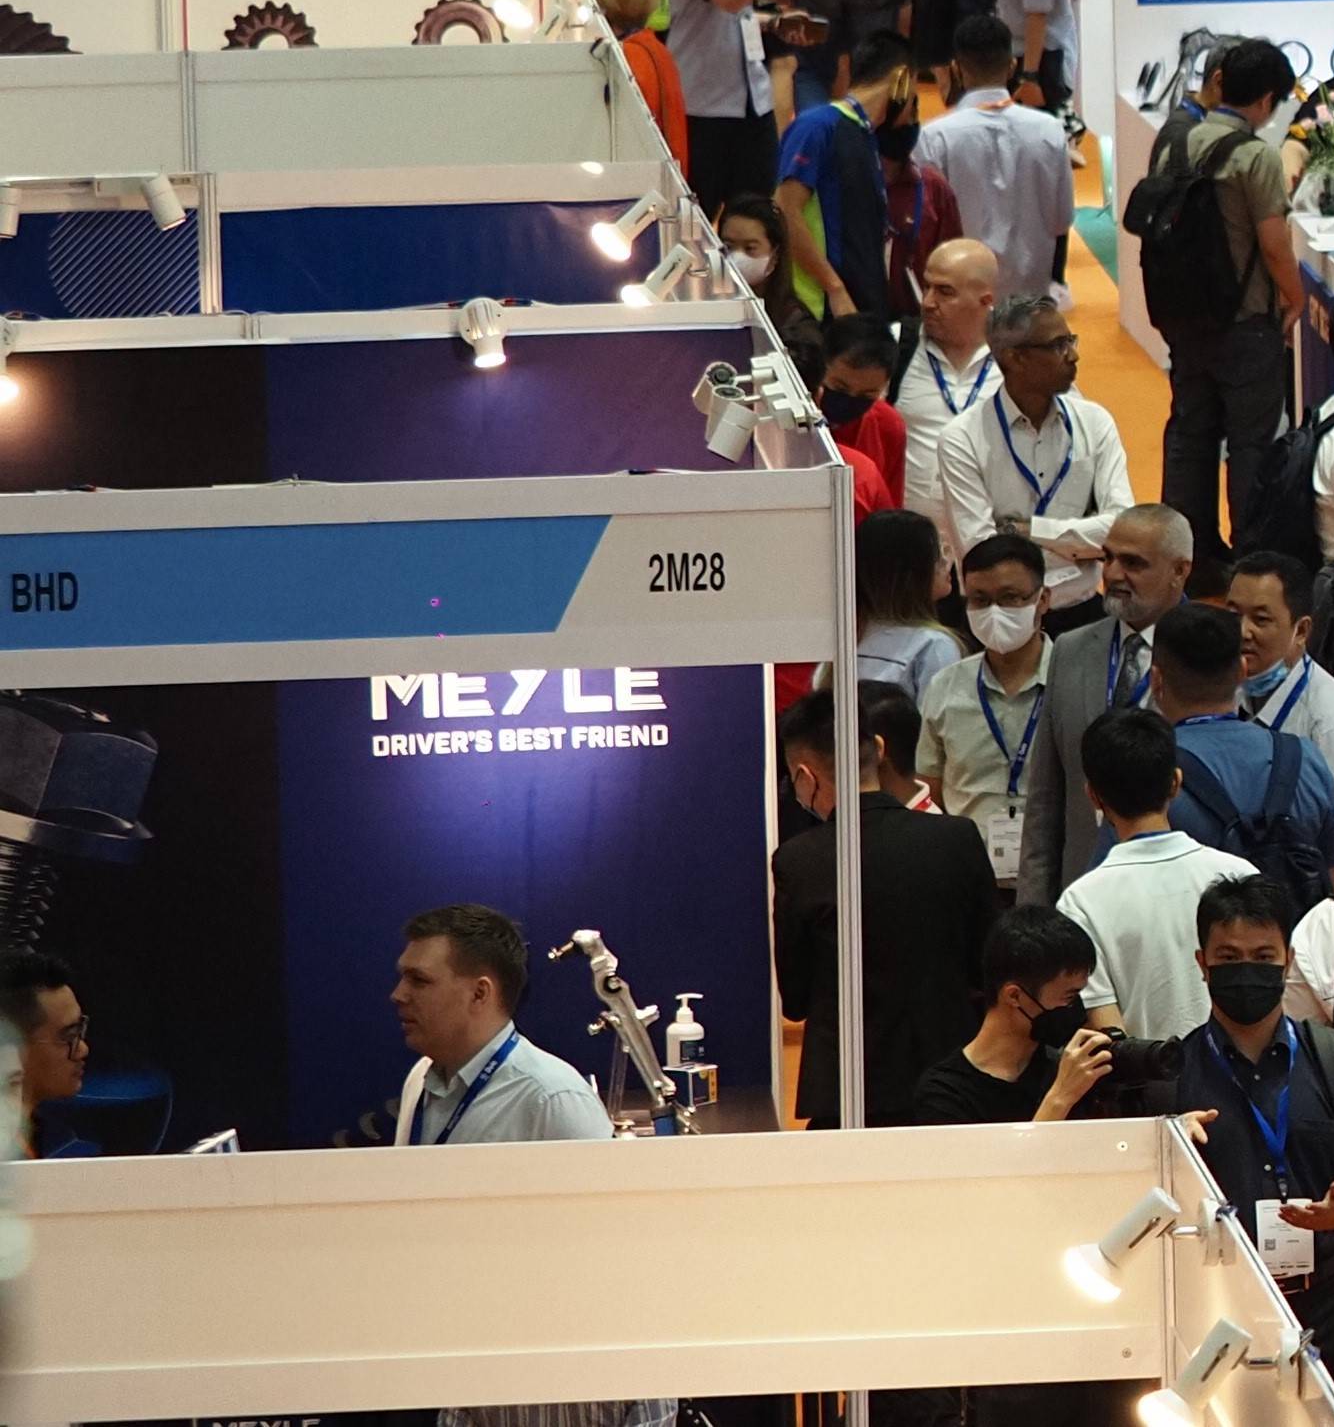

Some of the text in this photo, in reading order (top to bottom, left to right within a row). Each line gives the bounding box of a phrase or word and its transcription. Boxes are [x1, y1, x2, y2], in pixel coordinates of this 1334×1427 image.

[10, 572, 79, 614] BHD
[648, 552, 726, 594] 2M28
[371, 667, 668, 720] MEYLE
[372, 724, 669, 757] DRIVER'S BEST FRIEND
